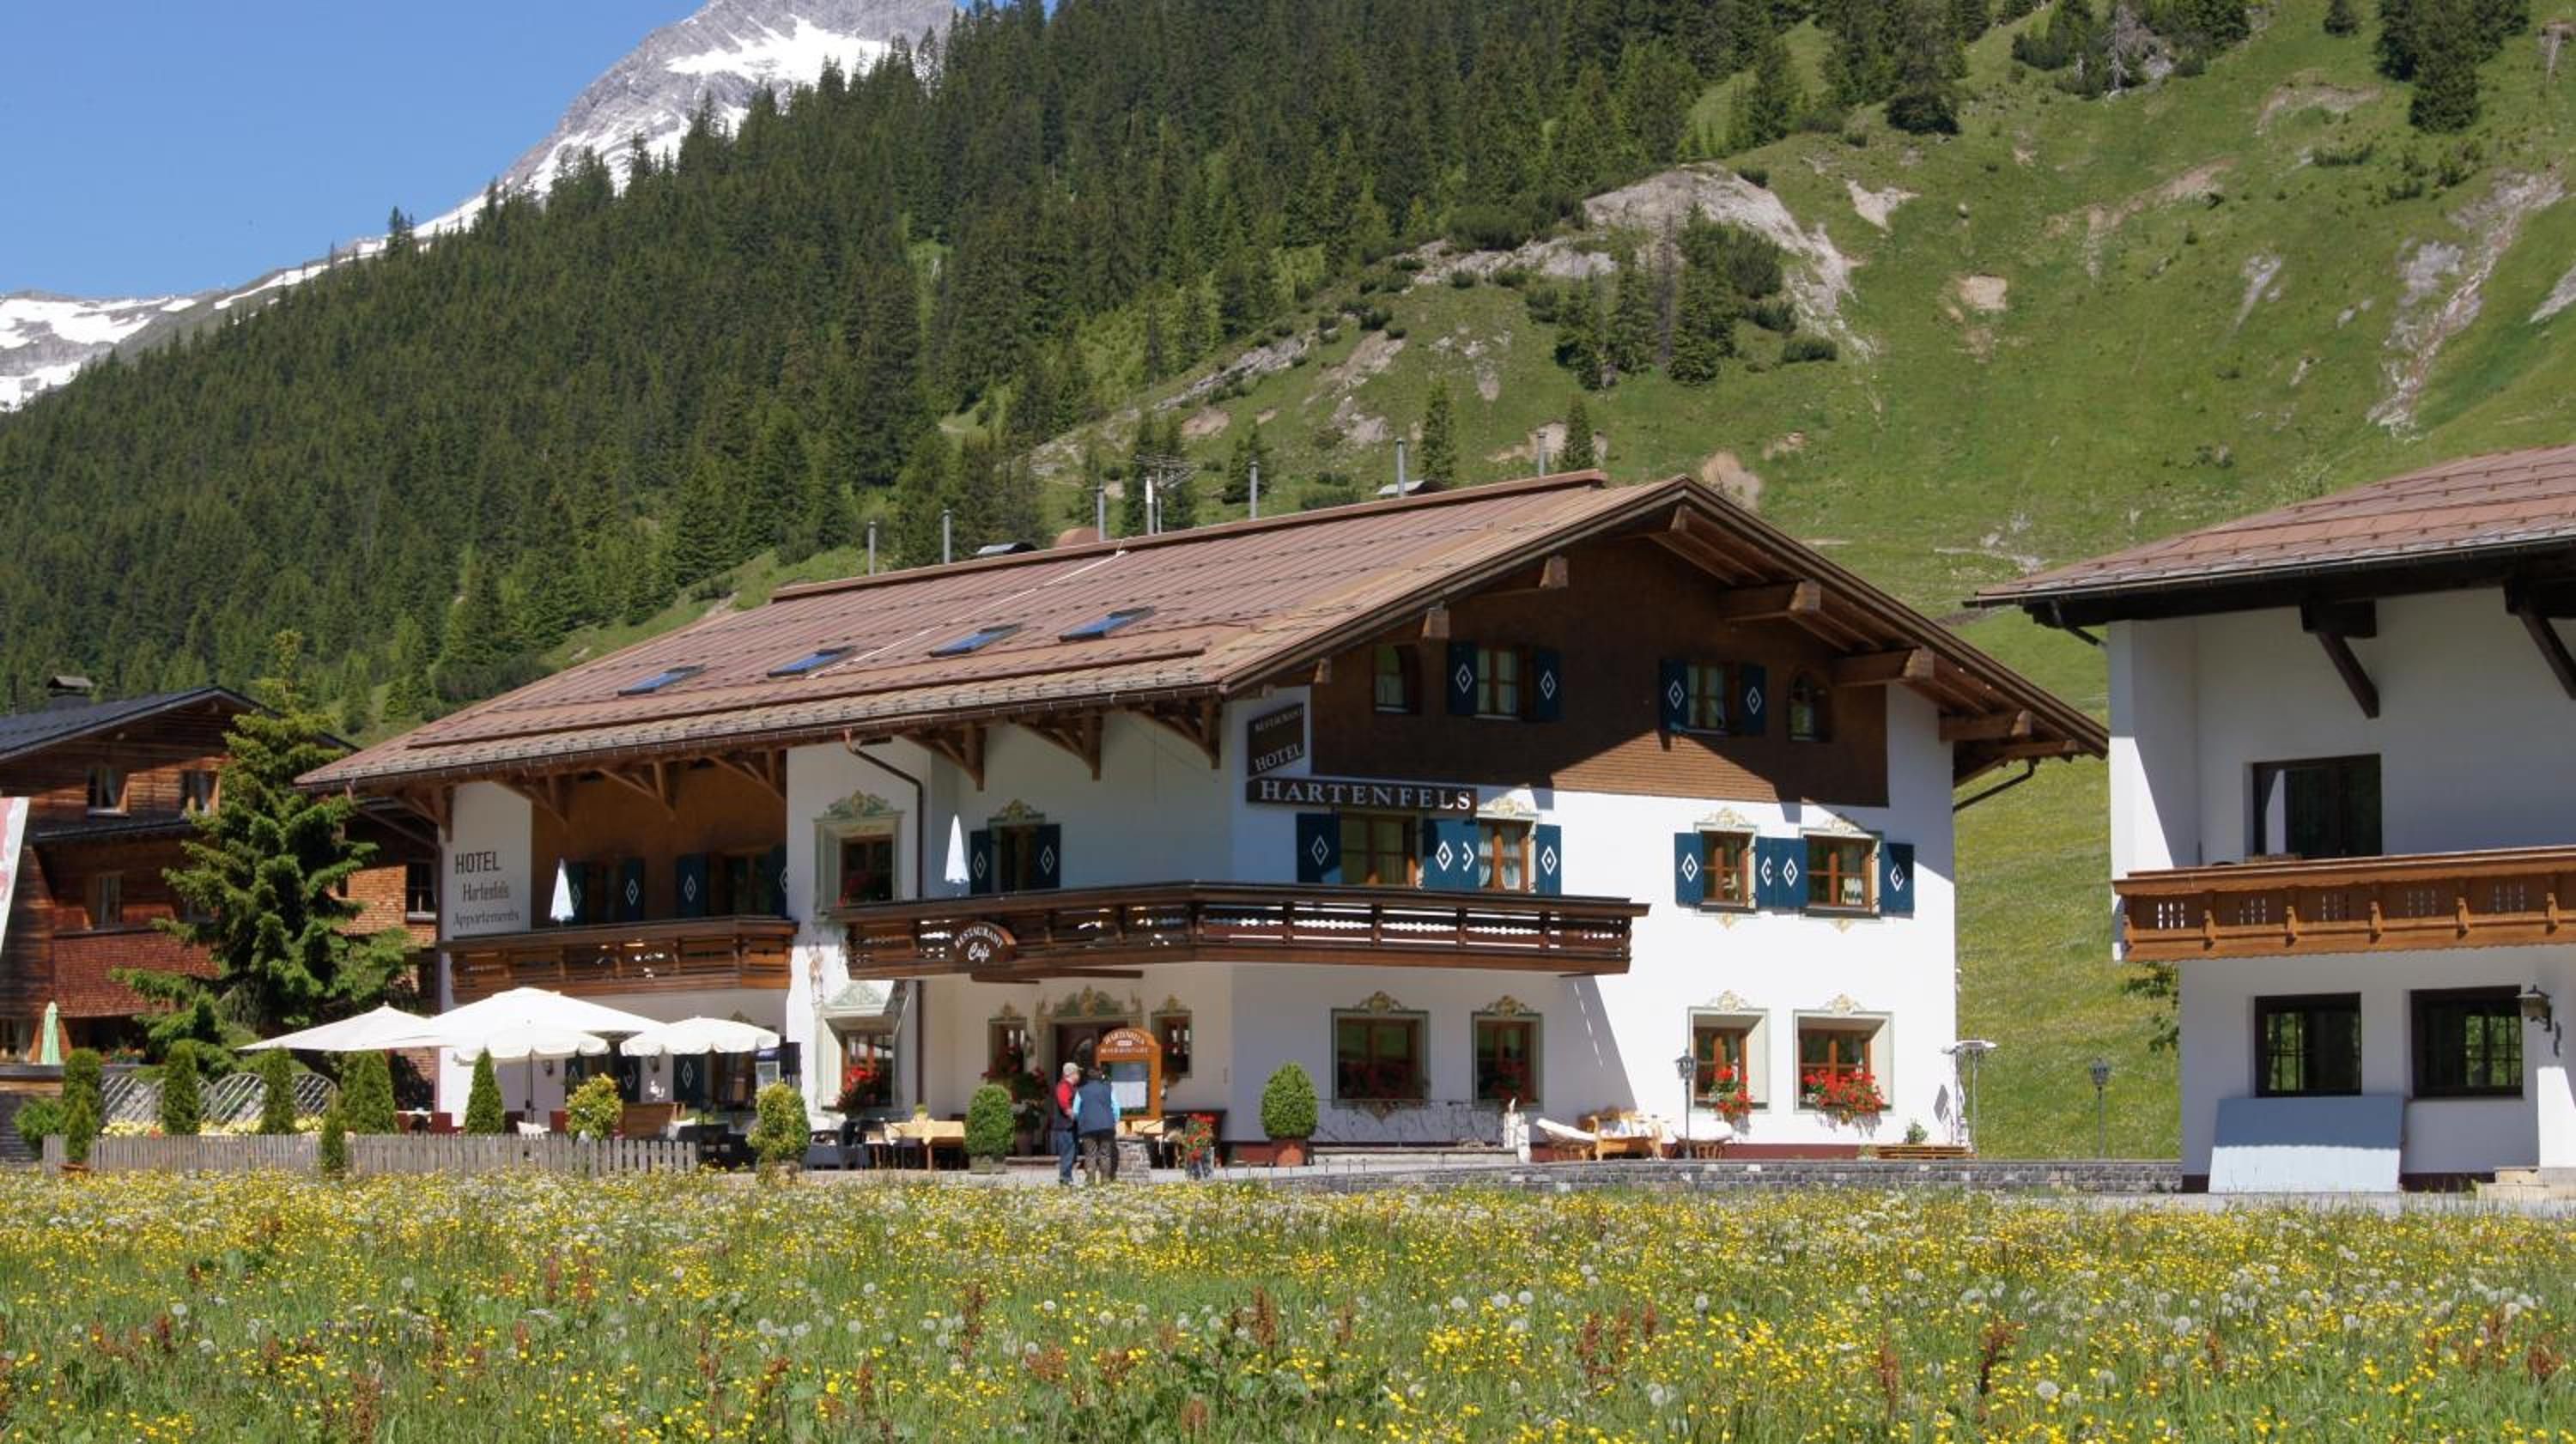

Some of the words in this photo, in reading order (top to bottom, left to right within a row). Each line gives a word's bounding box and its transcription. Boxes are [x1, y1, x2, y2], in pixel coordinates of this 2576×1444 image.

[1255, 743, 1302, 771] HOTEL
[1261, 780, 1471, 810] HARTENFELS
[455, 851, 501, 874] HOTEL
[954, 925, 1004, 949] RESTAURANT
